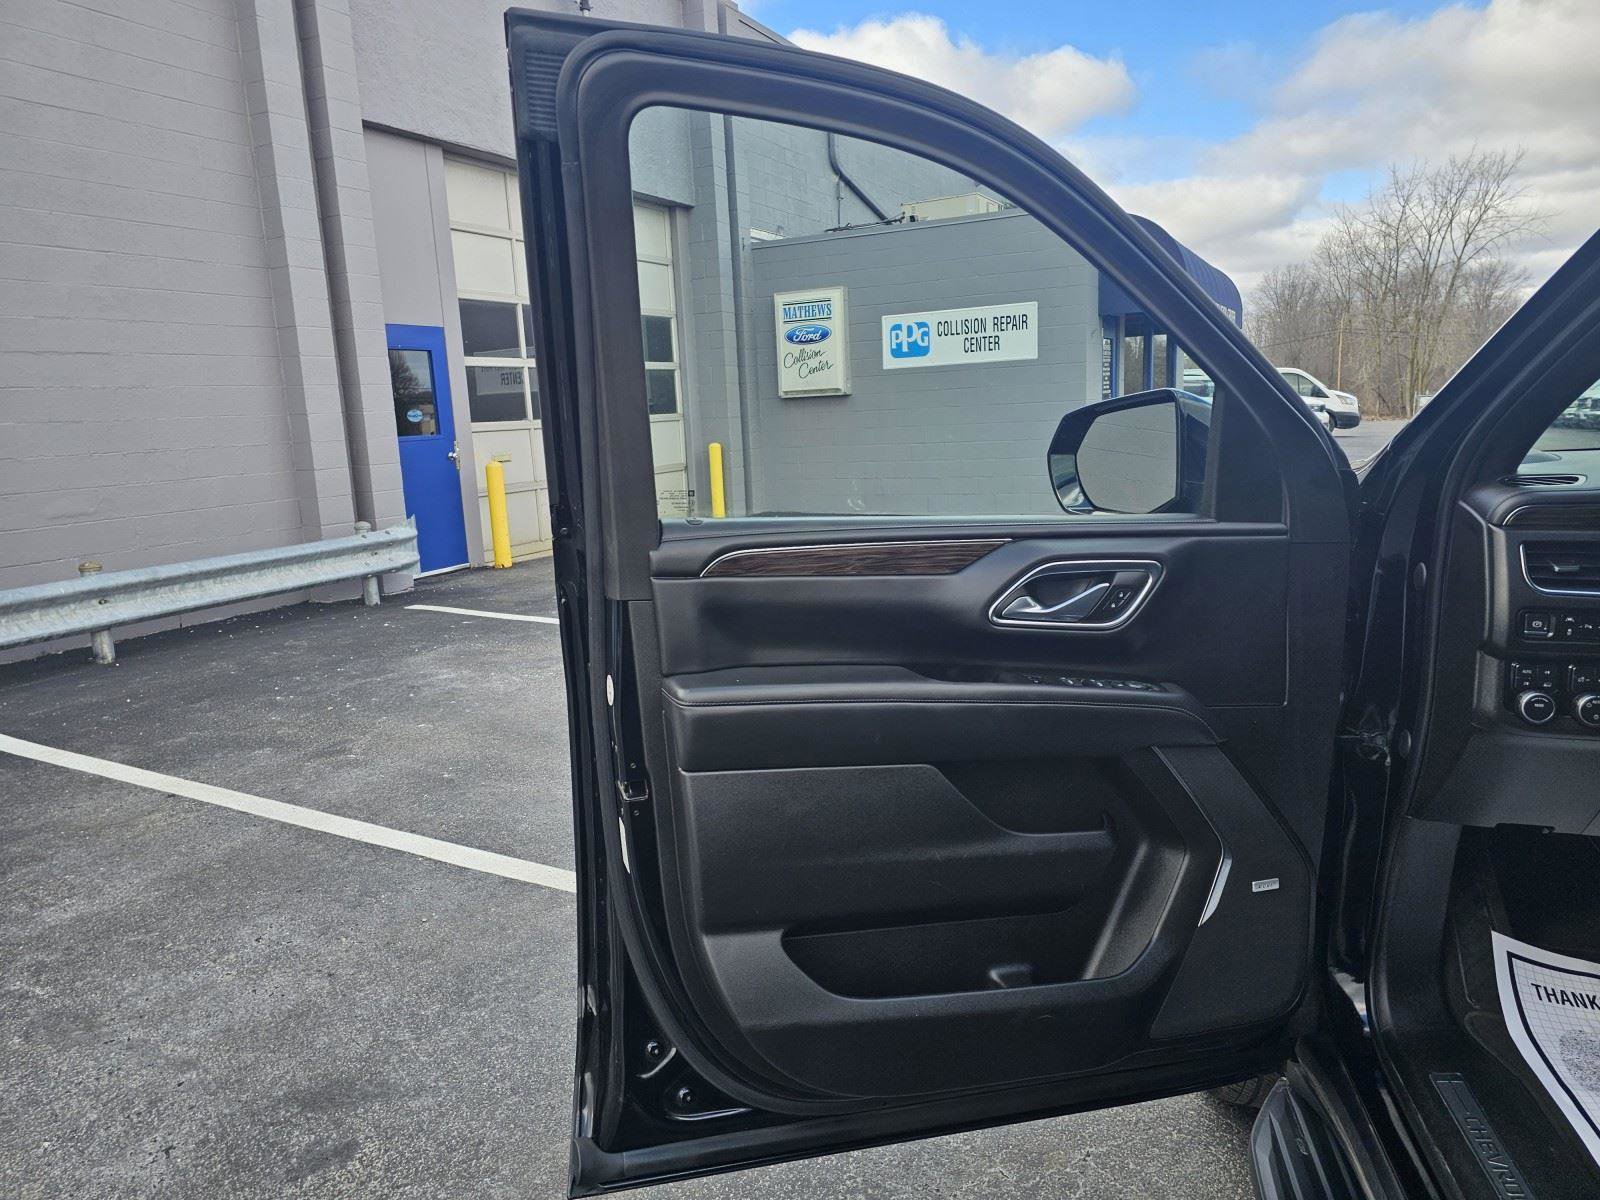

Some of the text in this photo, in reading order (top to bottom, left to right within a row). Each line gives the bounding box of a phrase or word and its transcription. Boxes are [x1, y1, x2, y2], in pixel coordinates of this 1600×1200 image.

[783, 303, 831, 320] MATHEWS
[793, 326, 822, 342] Ford
[937, 313, 1028, 337] COLLISION REPAIR
[891, 321, 929, 353] PPG
[963, 335, 1000, 353] CENTER
[783, 347, 826, 369] Collision
[798, 360, 833, 379] Center
[1530, 982, 1600, 1011] THANK
[1464, 1116, 1526, 1200] CHEVRO
